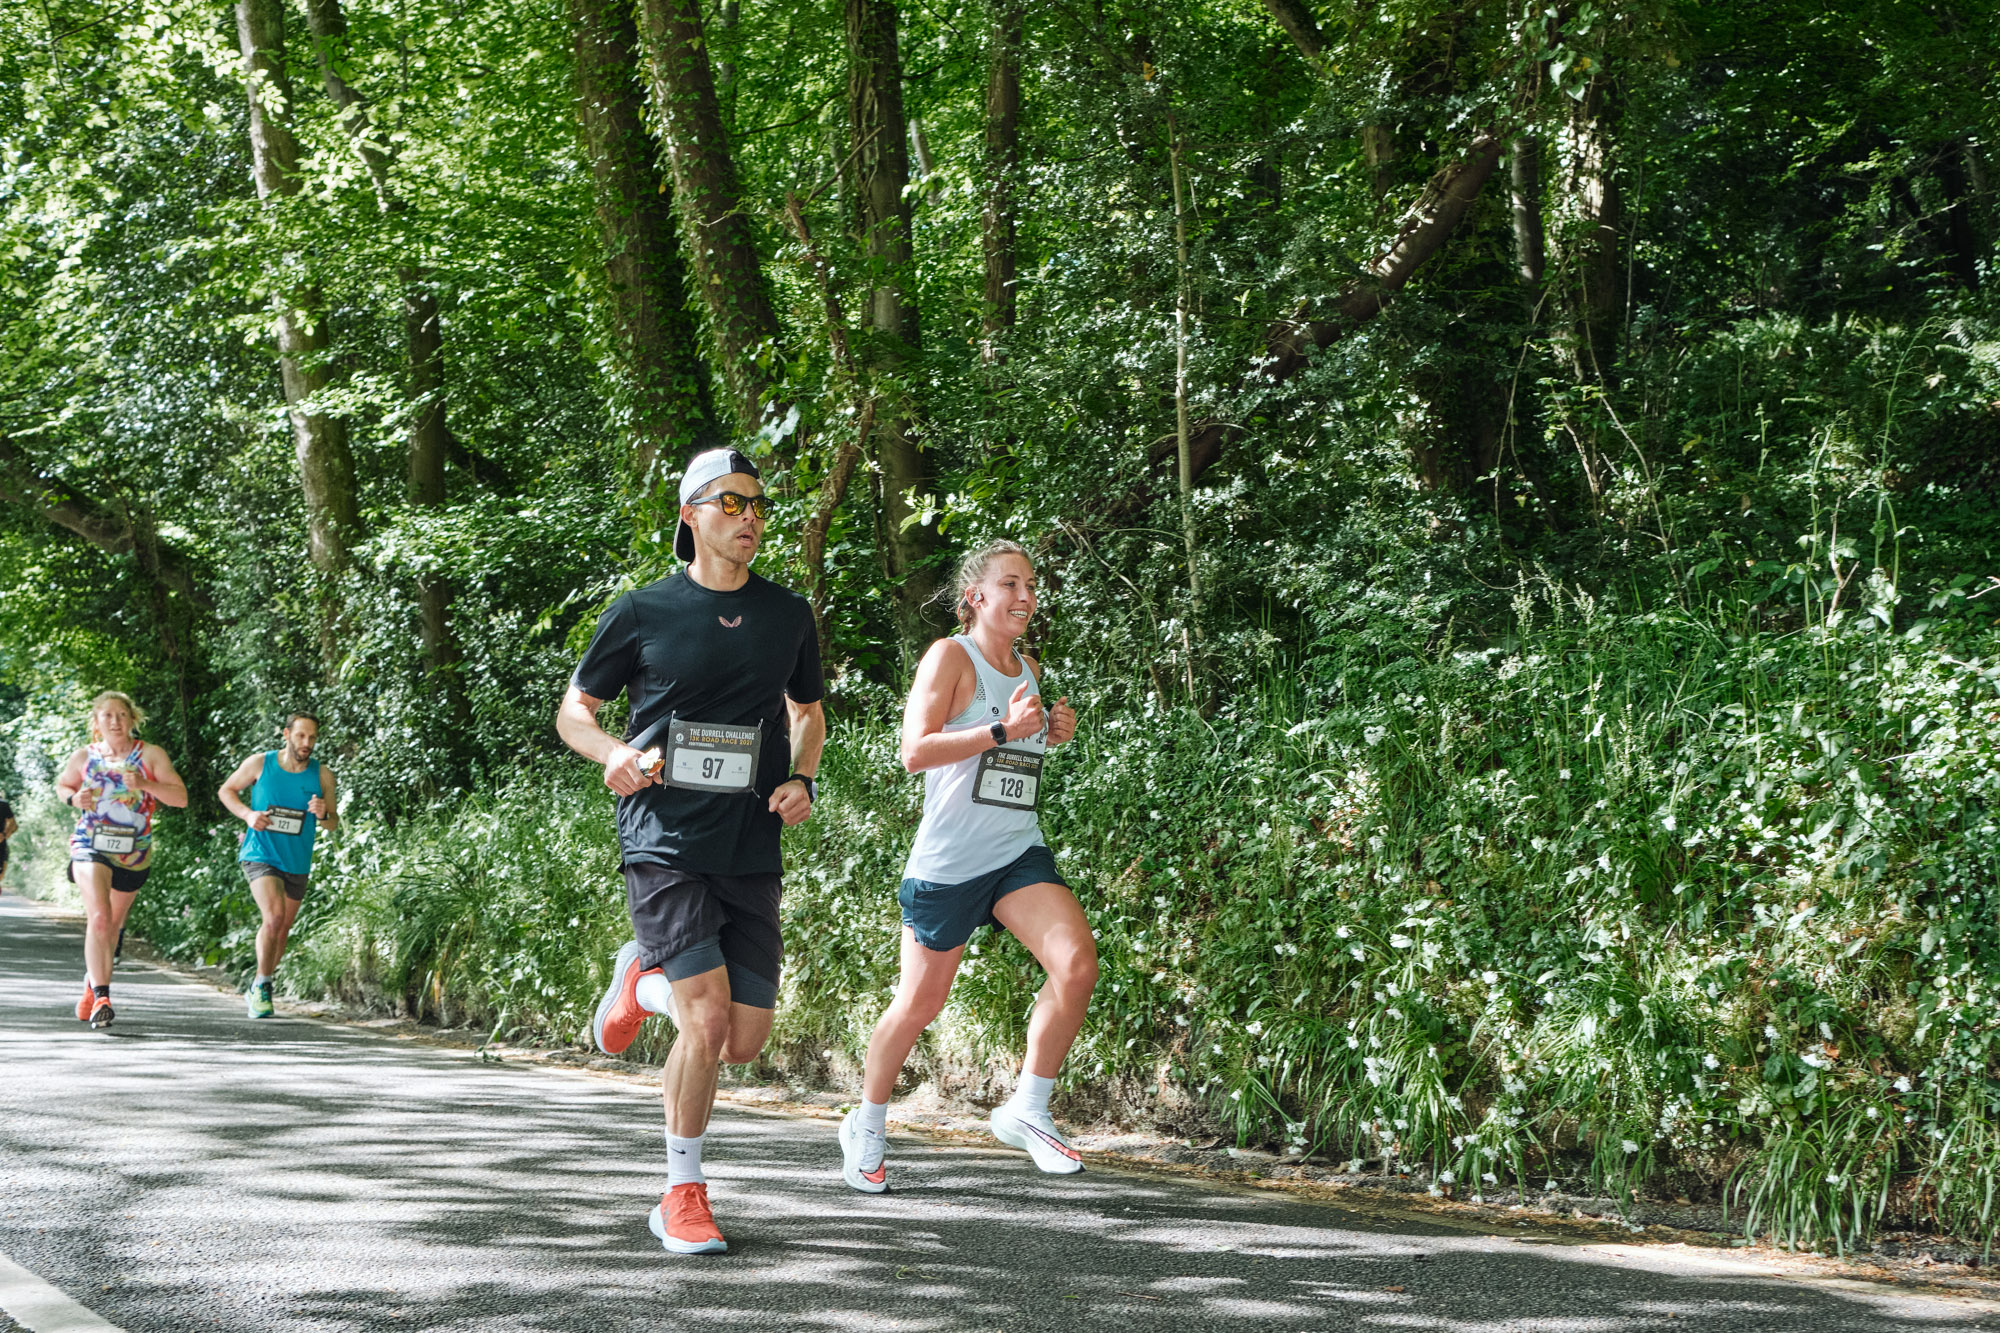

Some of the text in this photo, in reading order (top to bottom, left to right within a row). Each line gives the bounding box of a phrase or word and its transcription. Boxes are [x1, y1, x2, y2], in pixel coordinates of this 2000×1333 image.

[702, 729, 724, 738] DURRELL
[726, 731, 755, 740] CHALLENGE
[702, 757, 725, 780] 97
[1000, 777, 1024, 799] 128
[278, 819, 290, 830] 121
[106, 839, 121, 850] 172
